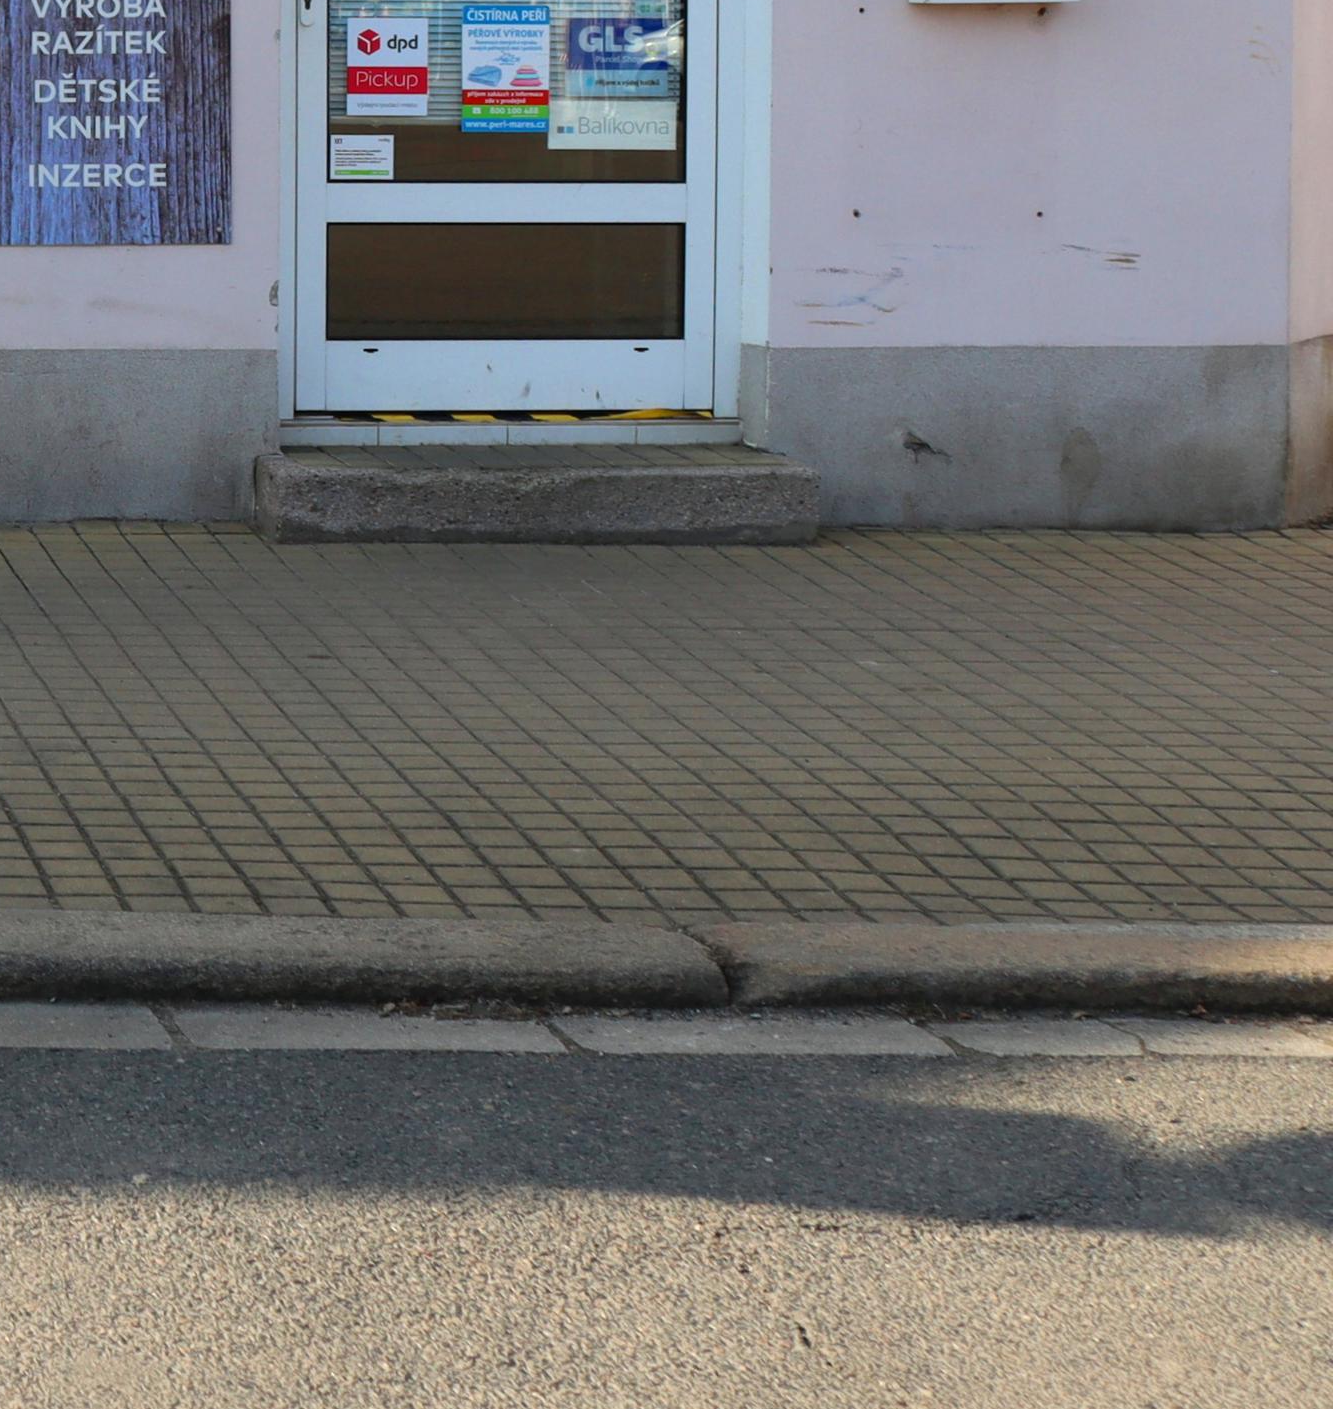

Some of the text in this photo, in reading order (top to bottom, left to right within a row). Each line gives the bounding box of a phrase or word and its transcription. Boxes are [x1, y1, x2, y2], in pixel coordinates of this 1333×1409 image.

[467, 7, 547, 22] ČISTÍRNA PEŘÍ
[31, 24, 167, 54] RAZÍTEK
[387, 34, 418, 53] dpd
[468, 28, 545, 38] PÉŘOVÉ VÝROBKY
[578, 25, 645, 53] GLS
[34, 72, 161, 103] DĚTSKÉ
[356, 70, 419, 90] Pickup
[47, 115, 148, 139] KNIHY
[578, 116, 670, 135] Balíkovna
[28, 163, 167, 187] INZERCE
